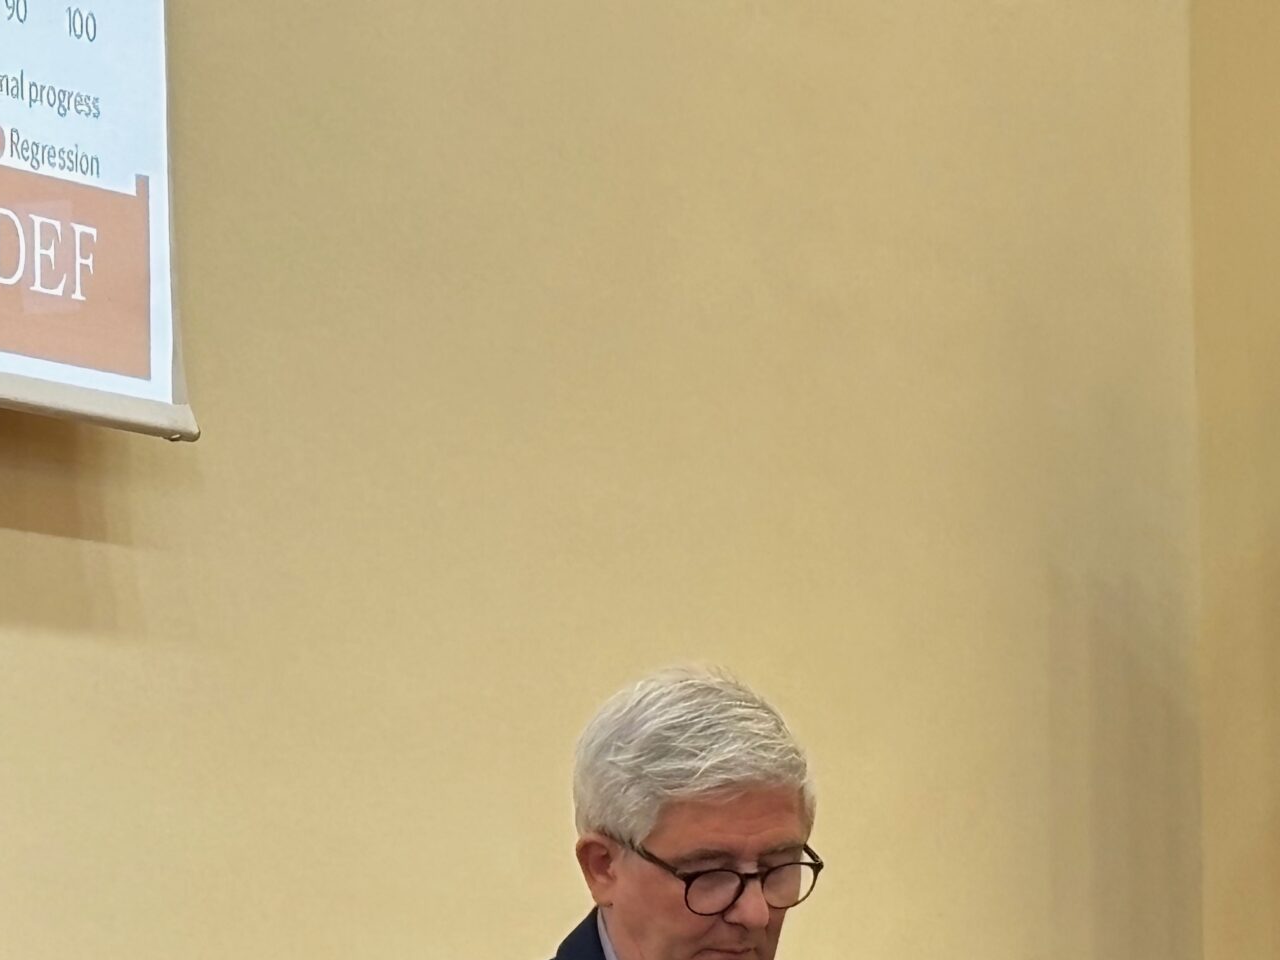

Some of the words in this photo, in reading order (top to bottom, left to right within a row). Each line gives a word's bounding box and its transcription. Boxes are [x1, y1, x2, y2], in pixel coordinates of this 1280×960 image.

[65, 6, 97, 42] 100
[28, 79, 101, 119] progress
[9, 127, 101, 178] Regression
